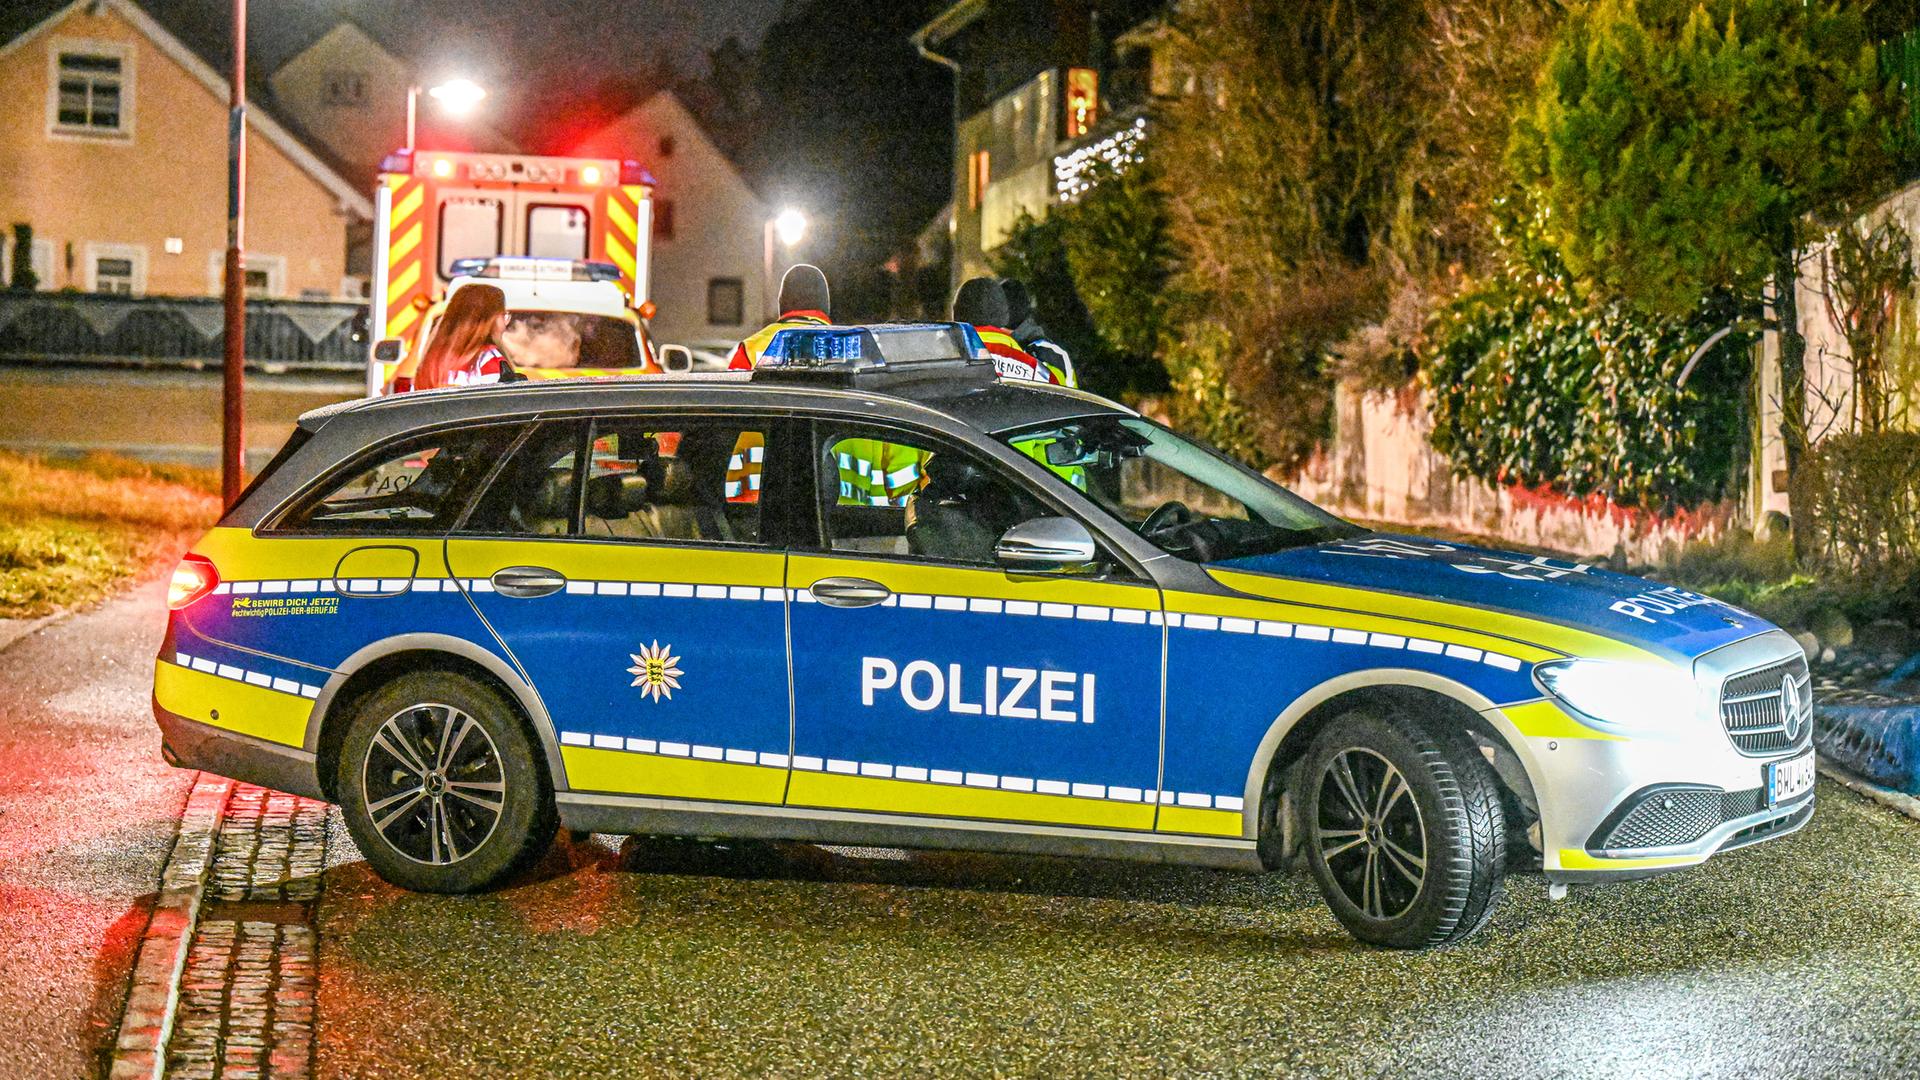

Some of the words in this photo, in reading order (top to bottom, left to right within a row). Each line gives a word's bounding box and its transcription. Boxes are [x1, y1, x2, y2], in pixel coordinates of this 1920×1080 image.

[252, 599, 284, 607] BEWIRB
[286, 598, 308, 606] DICH
[309, 597, 340, 606] JETZT!
[862, 656, 1096, 724] POLIZEI
